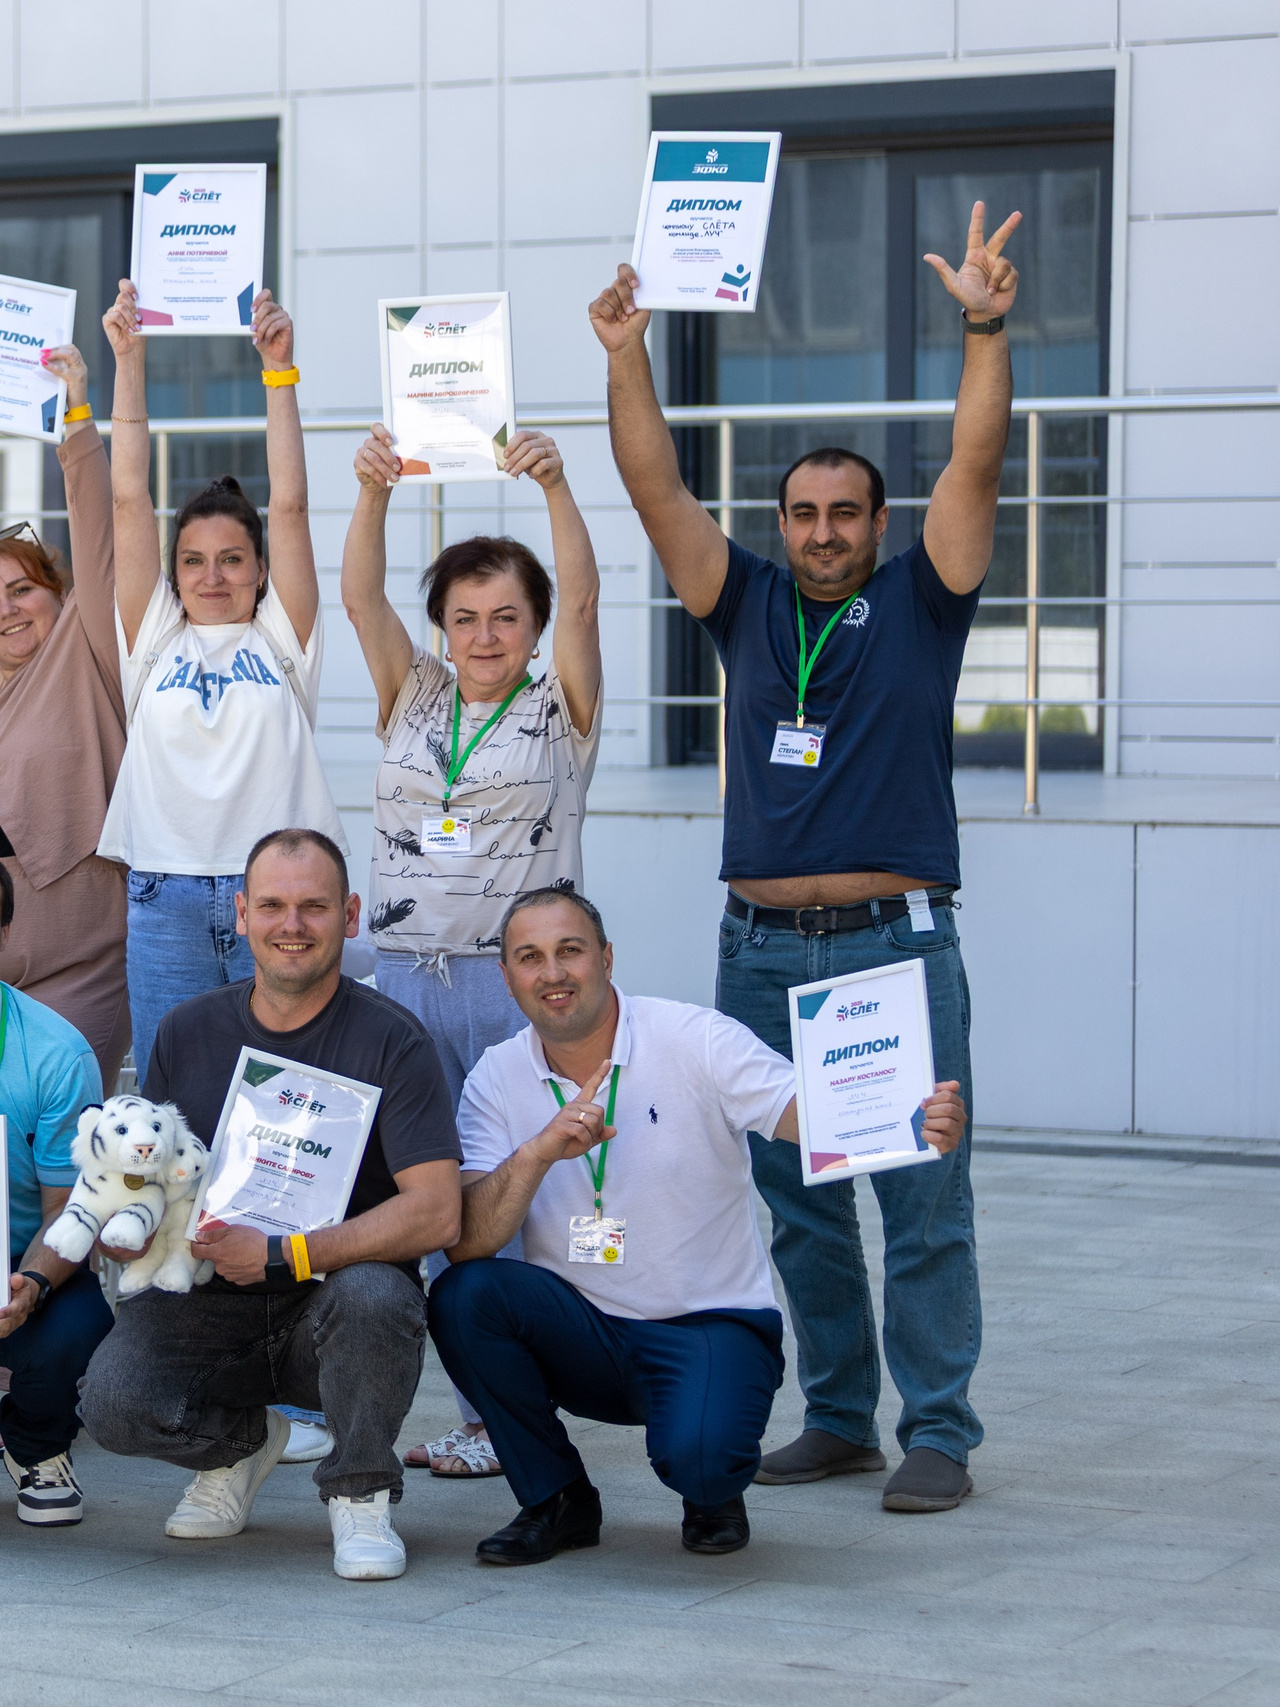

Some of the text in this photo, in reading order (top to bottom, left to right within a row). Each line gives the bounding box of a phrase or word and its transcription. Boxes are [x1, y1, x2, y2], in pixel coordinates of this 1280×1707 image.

[692, 166, 728, 174] ЭФКО
[192, 191, 222, 201] СЛЁТ
[666, 199, 742, 212] ДИПЛОМ
[160, 224, 236, 237] ДИПЛОМ
[703, 220, 735, 230] СЛЁТА
[5, 302, 33, 314] СЛЁТ
[438, 324, 467, 335] СЛЁТ
[409, 360, 484, 378] ДИПЛОМ
[850, 1001, 880, 1016] СЛЁТ
[823, 1035, 899, 1066] ДИПЛОМ
[830, 1075, 856, 1086] НАЗАРУ
[293, 1097, 326, 1114] СЛЁТ
[247, 1124, 332, 1159] ДИПЛОМ
